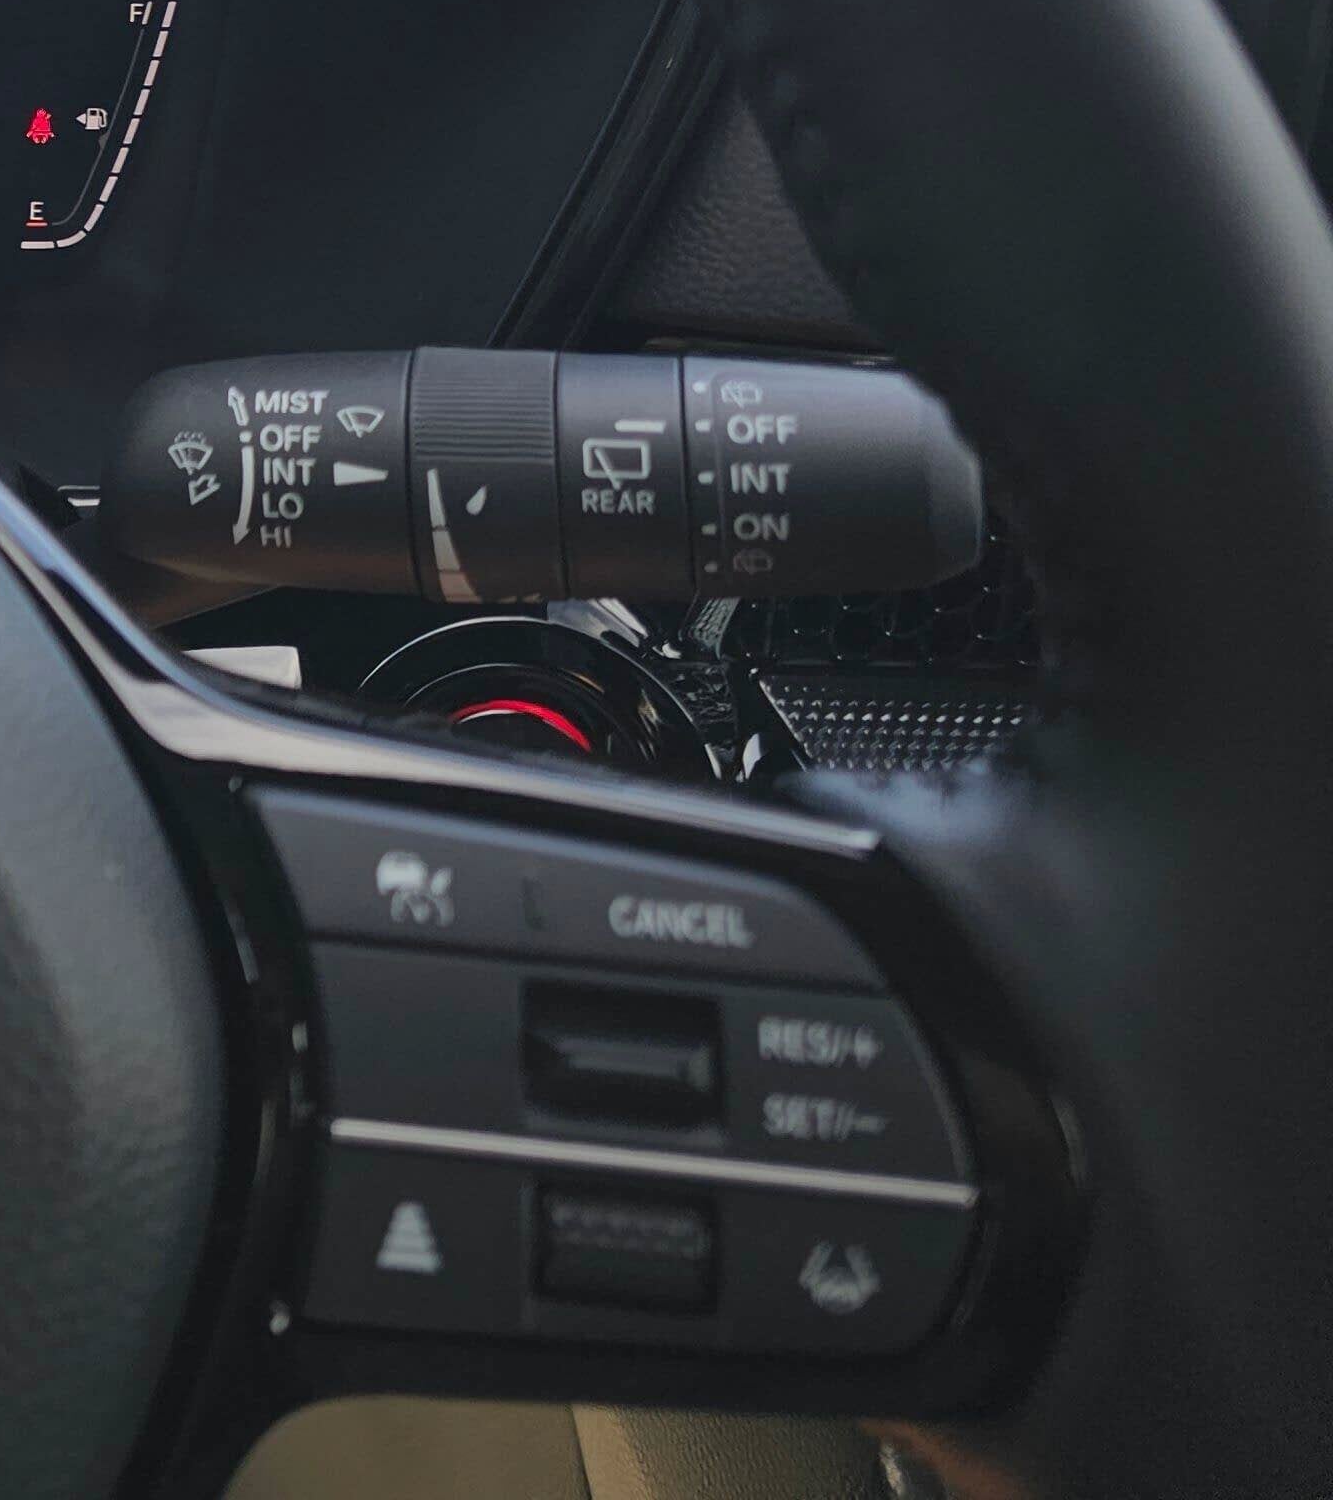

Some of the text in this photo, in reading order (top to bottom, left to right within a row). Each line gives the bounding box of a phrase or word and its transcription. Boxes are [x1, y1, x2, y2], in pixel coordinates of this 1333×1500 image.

[130, 3, 144, 23] F
[30, 202, 44, 220] E
[255, 389, 328, 415] MIST
[259, 426, 321, 451] OFF
[727, 416, 797, 444] OFF
[263, 459, 314, 485] INT
[730, 465, 789, 493] INT
[264, 494, 303, 519] LO
[581, 489, 655, 515] REAR
[260, 525, 293, 548] HI
[734, 514, 790, 542] ON
[608, 896, 755, 947] CANCEL
